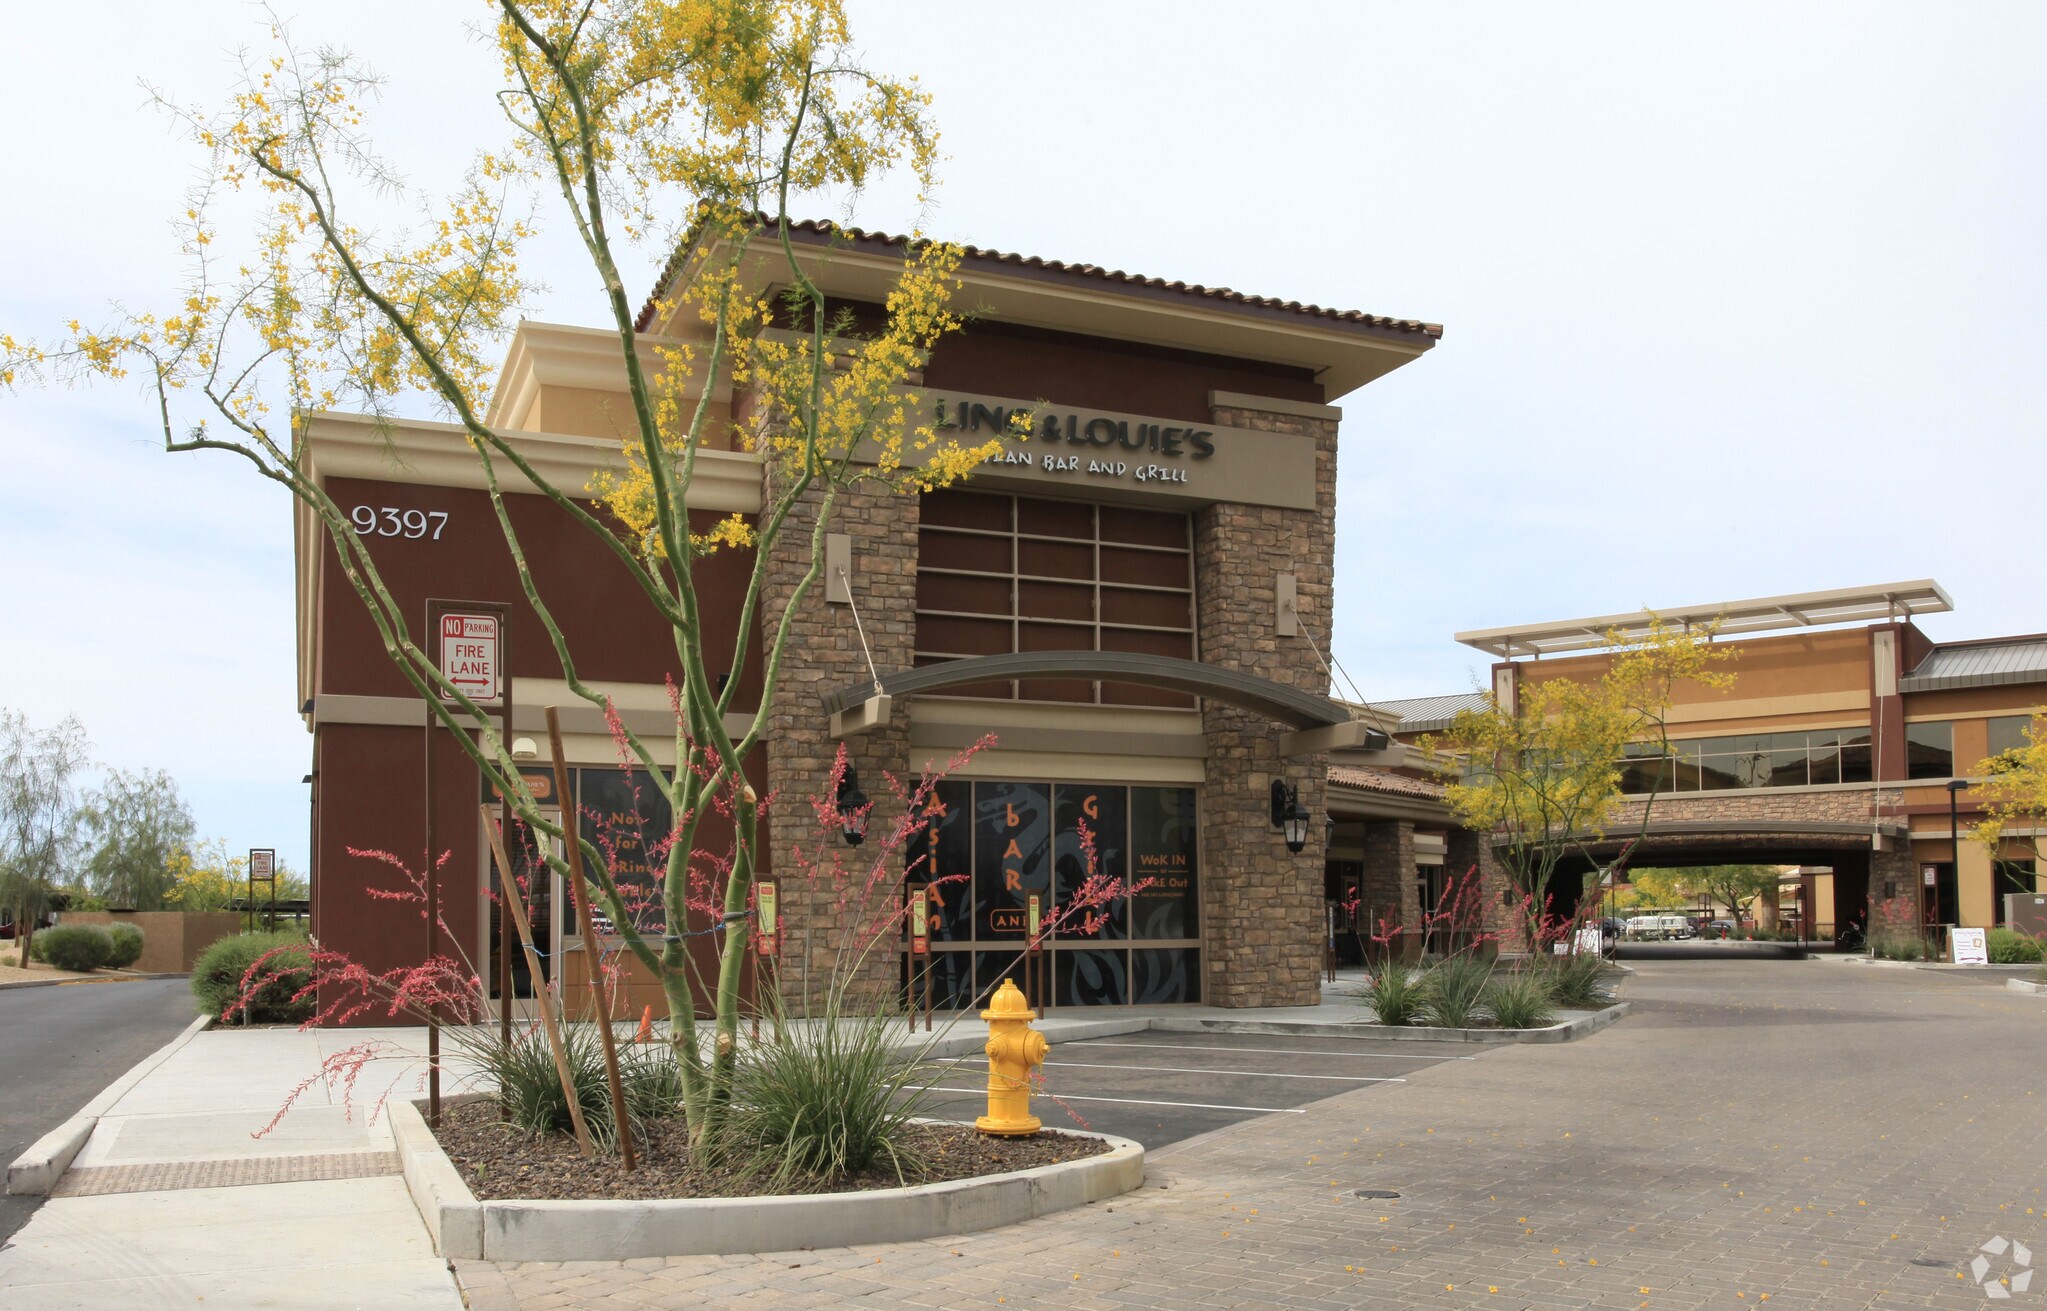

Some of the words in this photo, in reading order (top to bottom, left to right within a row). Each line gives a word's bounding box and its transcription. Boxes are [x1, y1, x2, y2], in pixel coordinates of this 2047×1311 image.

[1067, 414, 1216, 460] LOUIE'S
[1043, 454, 1079, 471] BAR
[1088, 459, 1127, 475] AND
[1135, 464, 1188, 482] GRILL
[351, 505, 449, 540] 9397
[446, 619, 461, 635] NO
[464, 623, 494, 633] PARKING
[455, 644, 486, 659] FIRE
[451, 660, 490, 675] LANE
